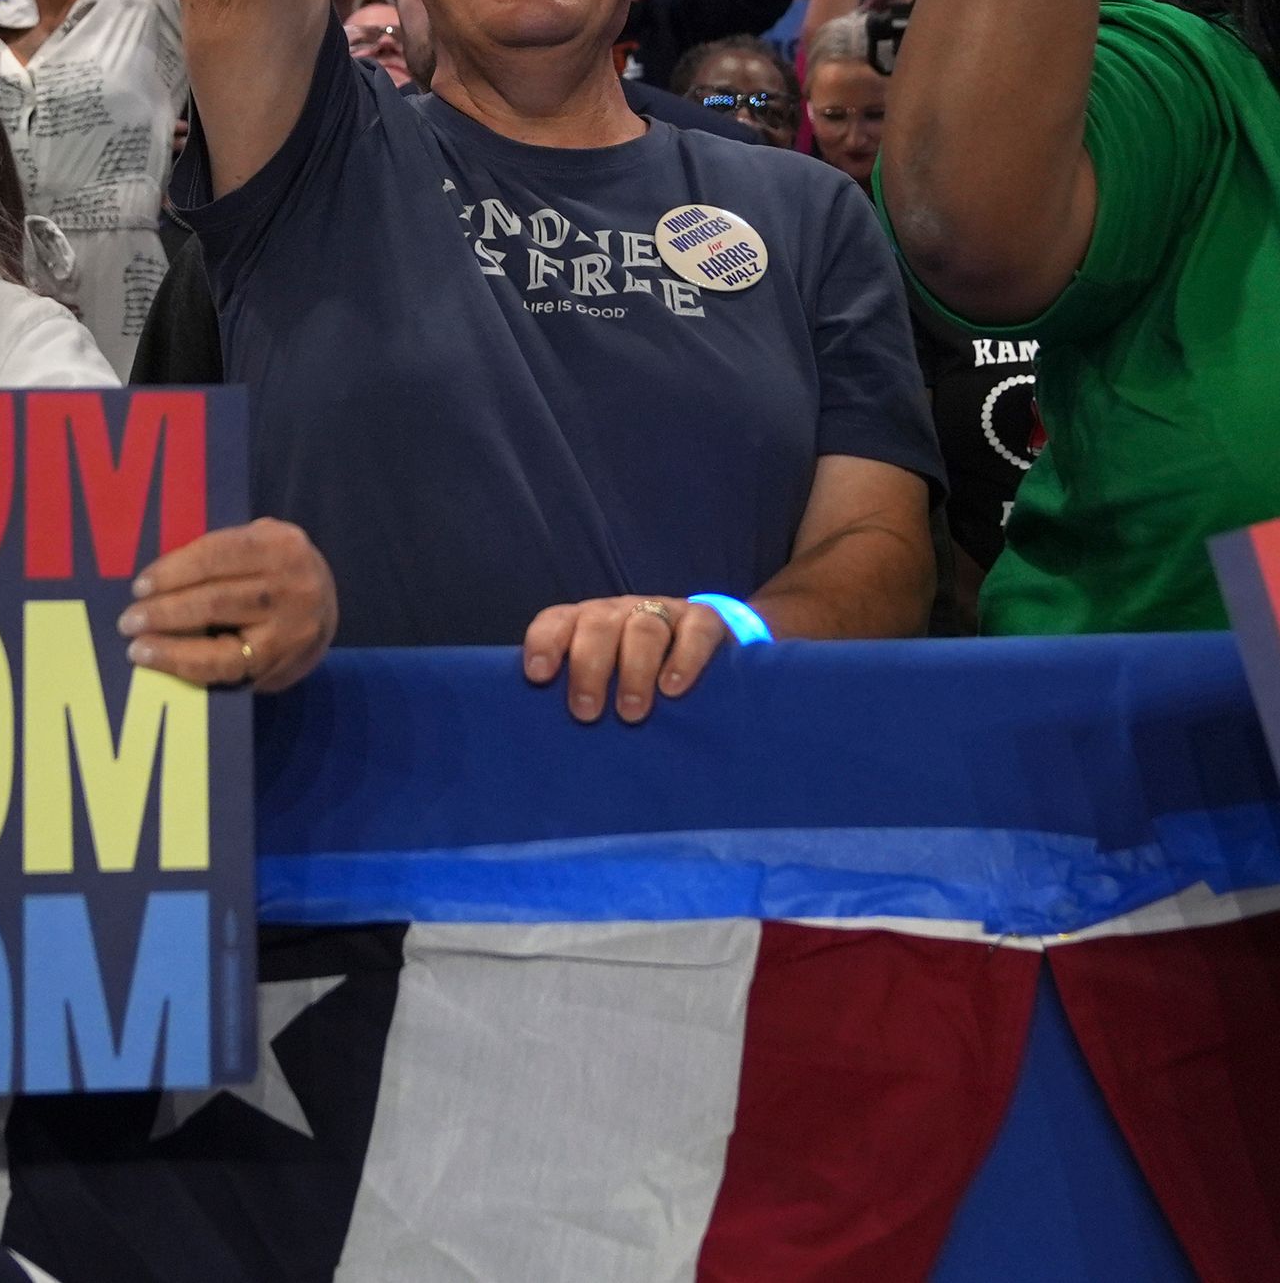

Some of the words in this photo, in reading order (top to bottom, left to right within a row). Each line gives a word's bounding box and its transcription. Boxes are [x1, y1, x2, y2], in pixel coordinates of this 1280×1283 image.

[663, 207, 709, 233] UNION
[668, 216, 732, 254] WORKERS
[707, 238, 724, 256] for
[696, 242, 759, 281] HARRIS
[721, 261, 762, 288] WALZ
[557, 299, 572, 312] IS
[575, 304, 627, 319] GOOD
[972, 338, 1040, 368] KAM
